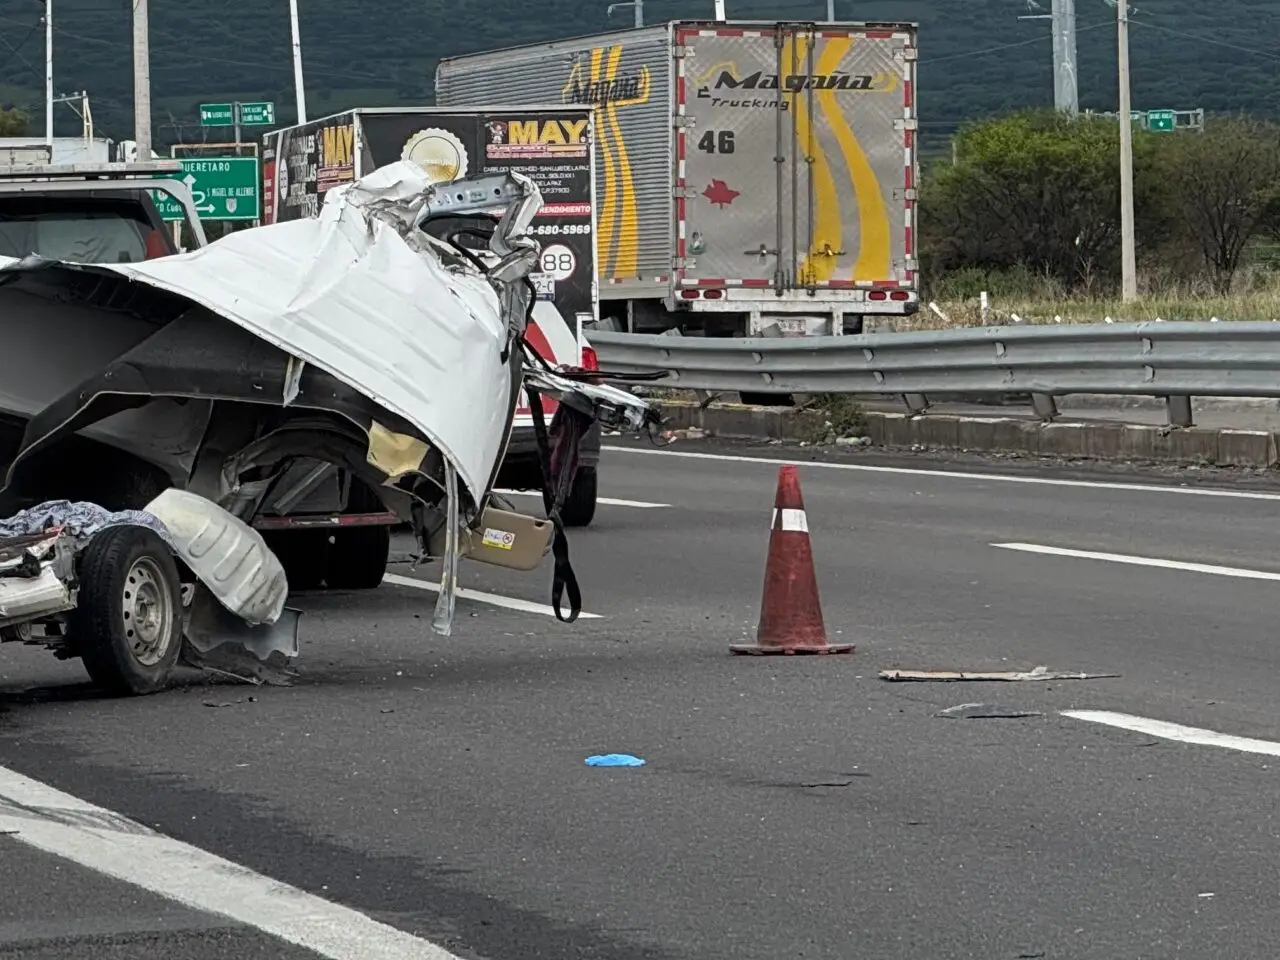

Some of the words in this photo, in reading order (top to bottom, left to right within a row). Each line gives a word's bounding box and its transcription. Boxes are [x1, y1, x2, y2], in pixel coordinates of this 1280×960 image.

[715, 70, 873, 93] Magaña
[711, 98, 790, 111] Trucking
[508, 120, 588, 144] MAY
[698, 130, 735, 154] 46
[323, 124, 355, 167] MAY
[538, 205, 591, 214] RENDIMIENTO
[543, 254, 571, 271] 88
